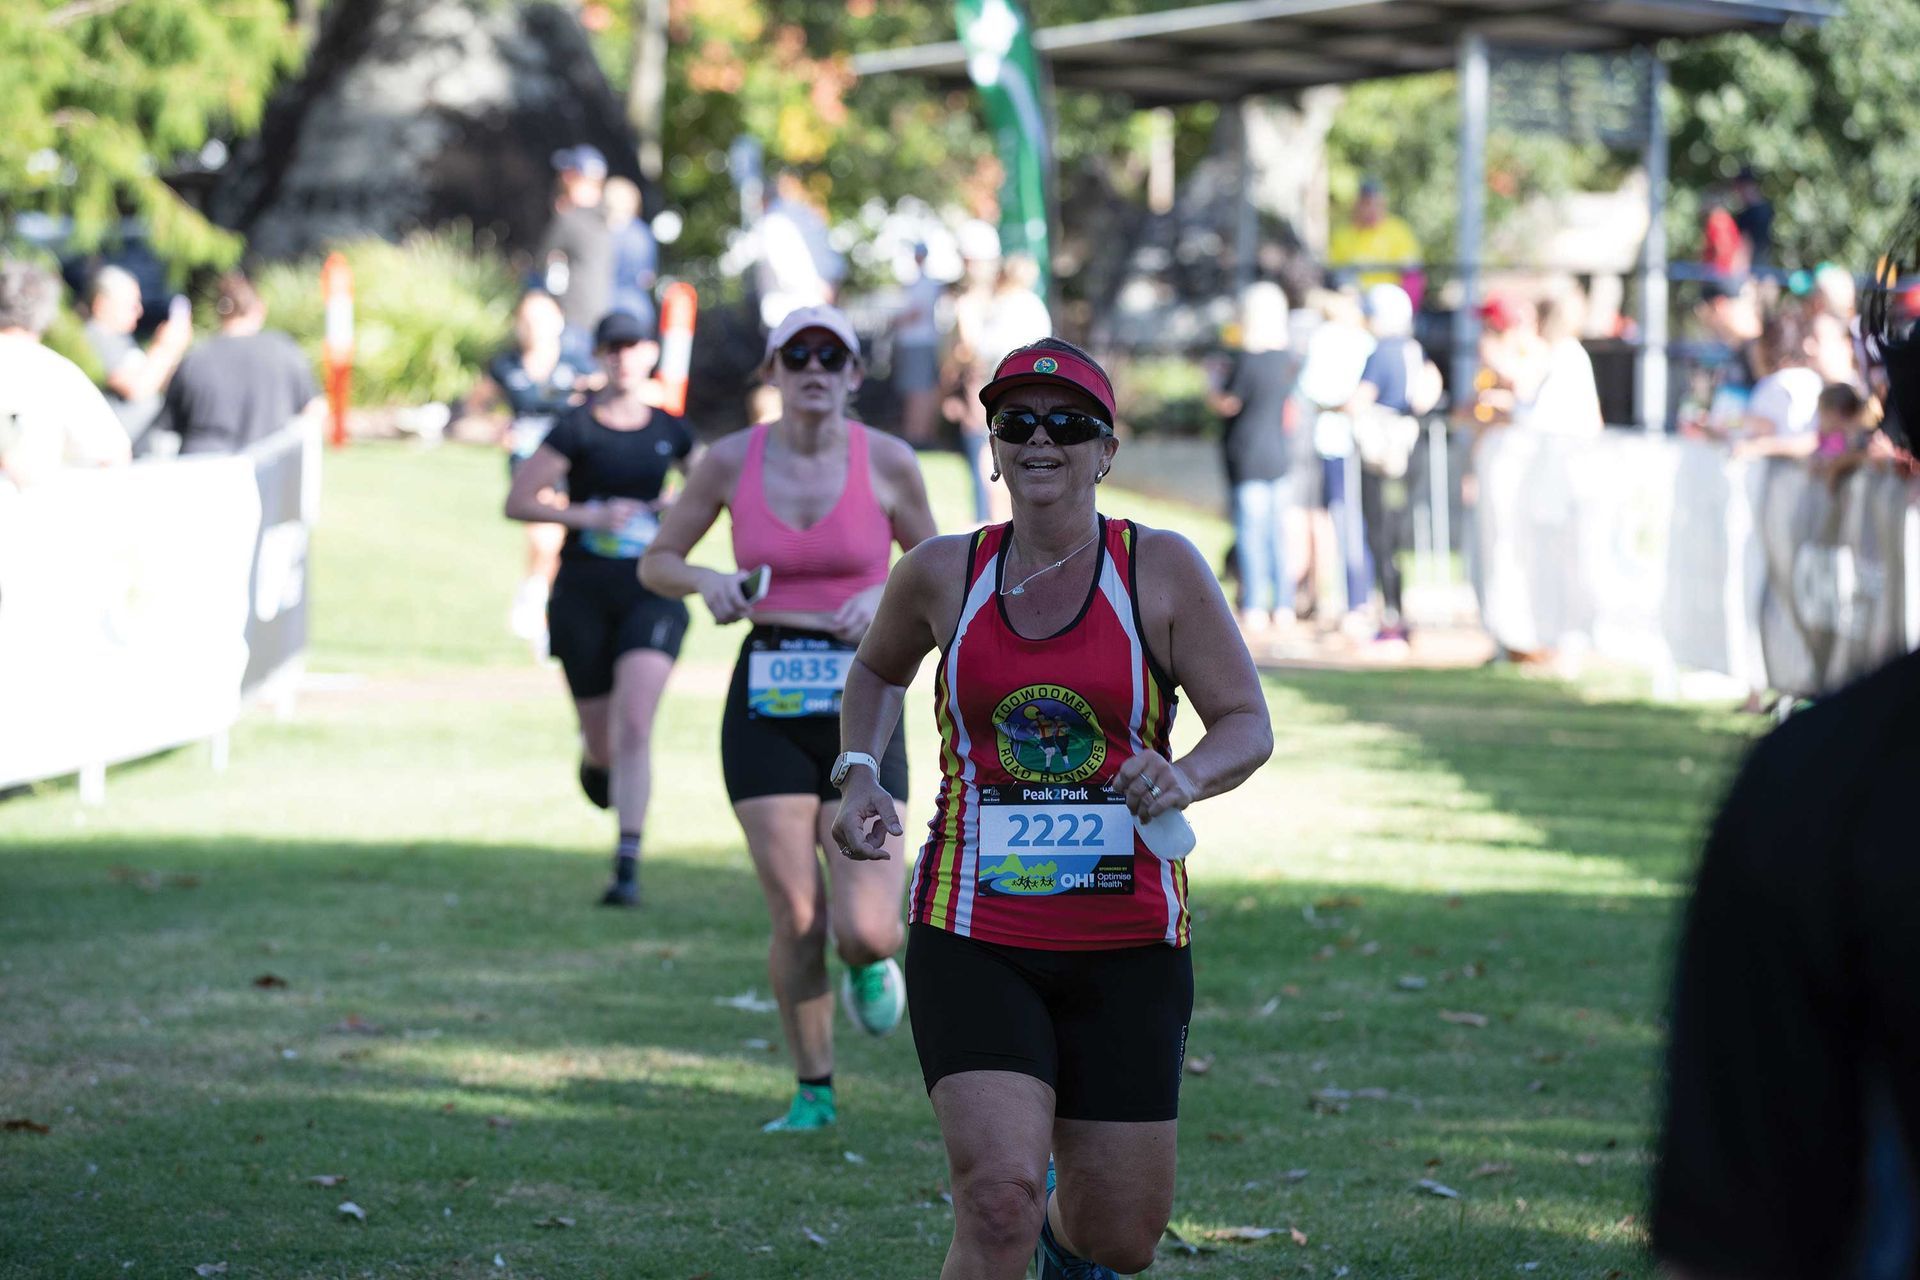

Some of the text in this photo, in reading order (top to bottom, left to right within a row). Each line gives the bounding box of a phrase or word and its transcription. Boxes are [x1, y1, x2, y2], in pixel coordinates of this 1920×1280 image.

[770, 658, 838, 681] 0835
[994, 687, 1092, 720] TOOWOOMBA
[1000, 745, 1103, 782] ROAD RUNNERS
[1023, 787, 1088, 800] Peak2Park
[1007, 813, 1104, 847] 2222
[1060, 873, 1095, 888] OH!
[1097, 872, 1131, 881] Optimise
